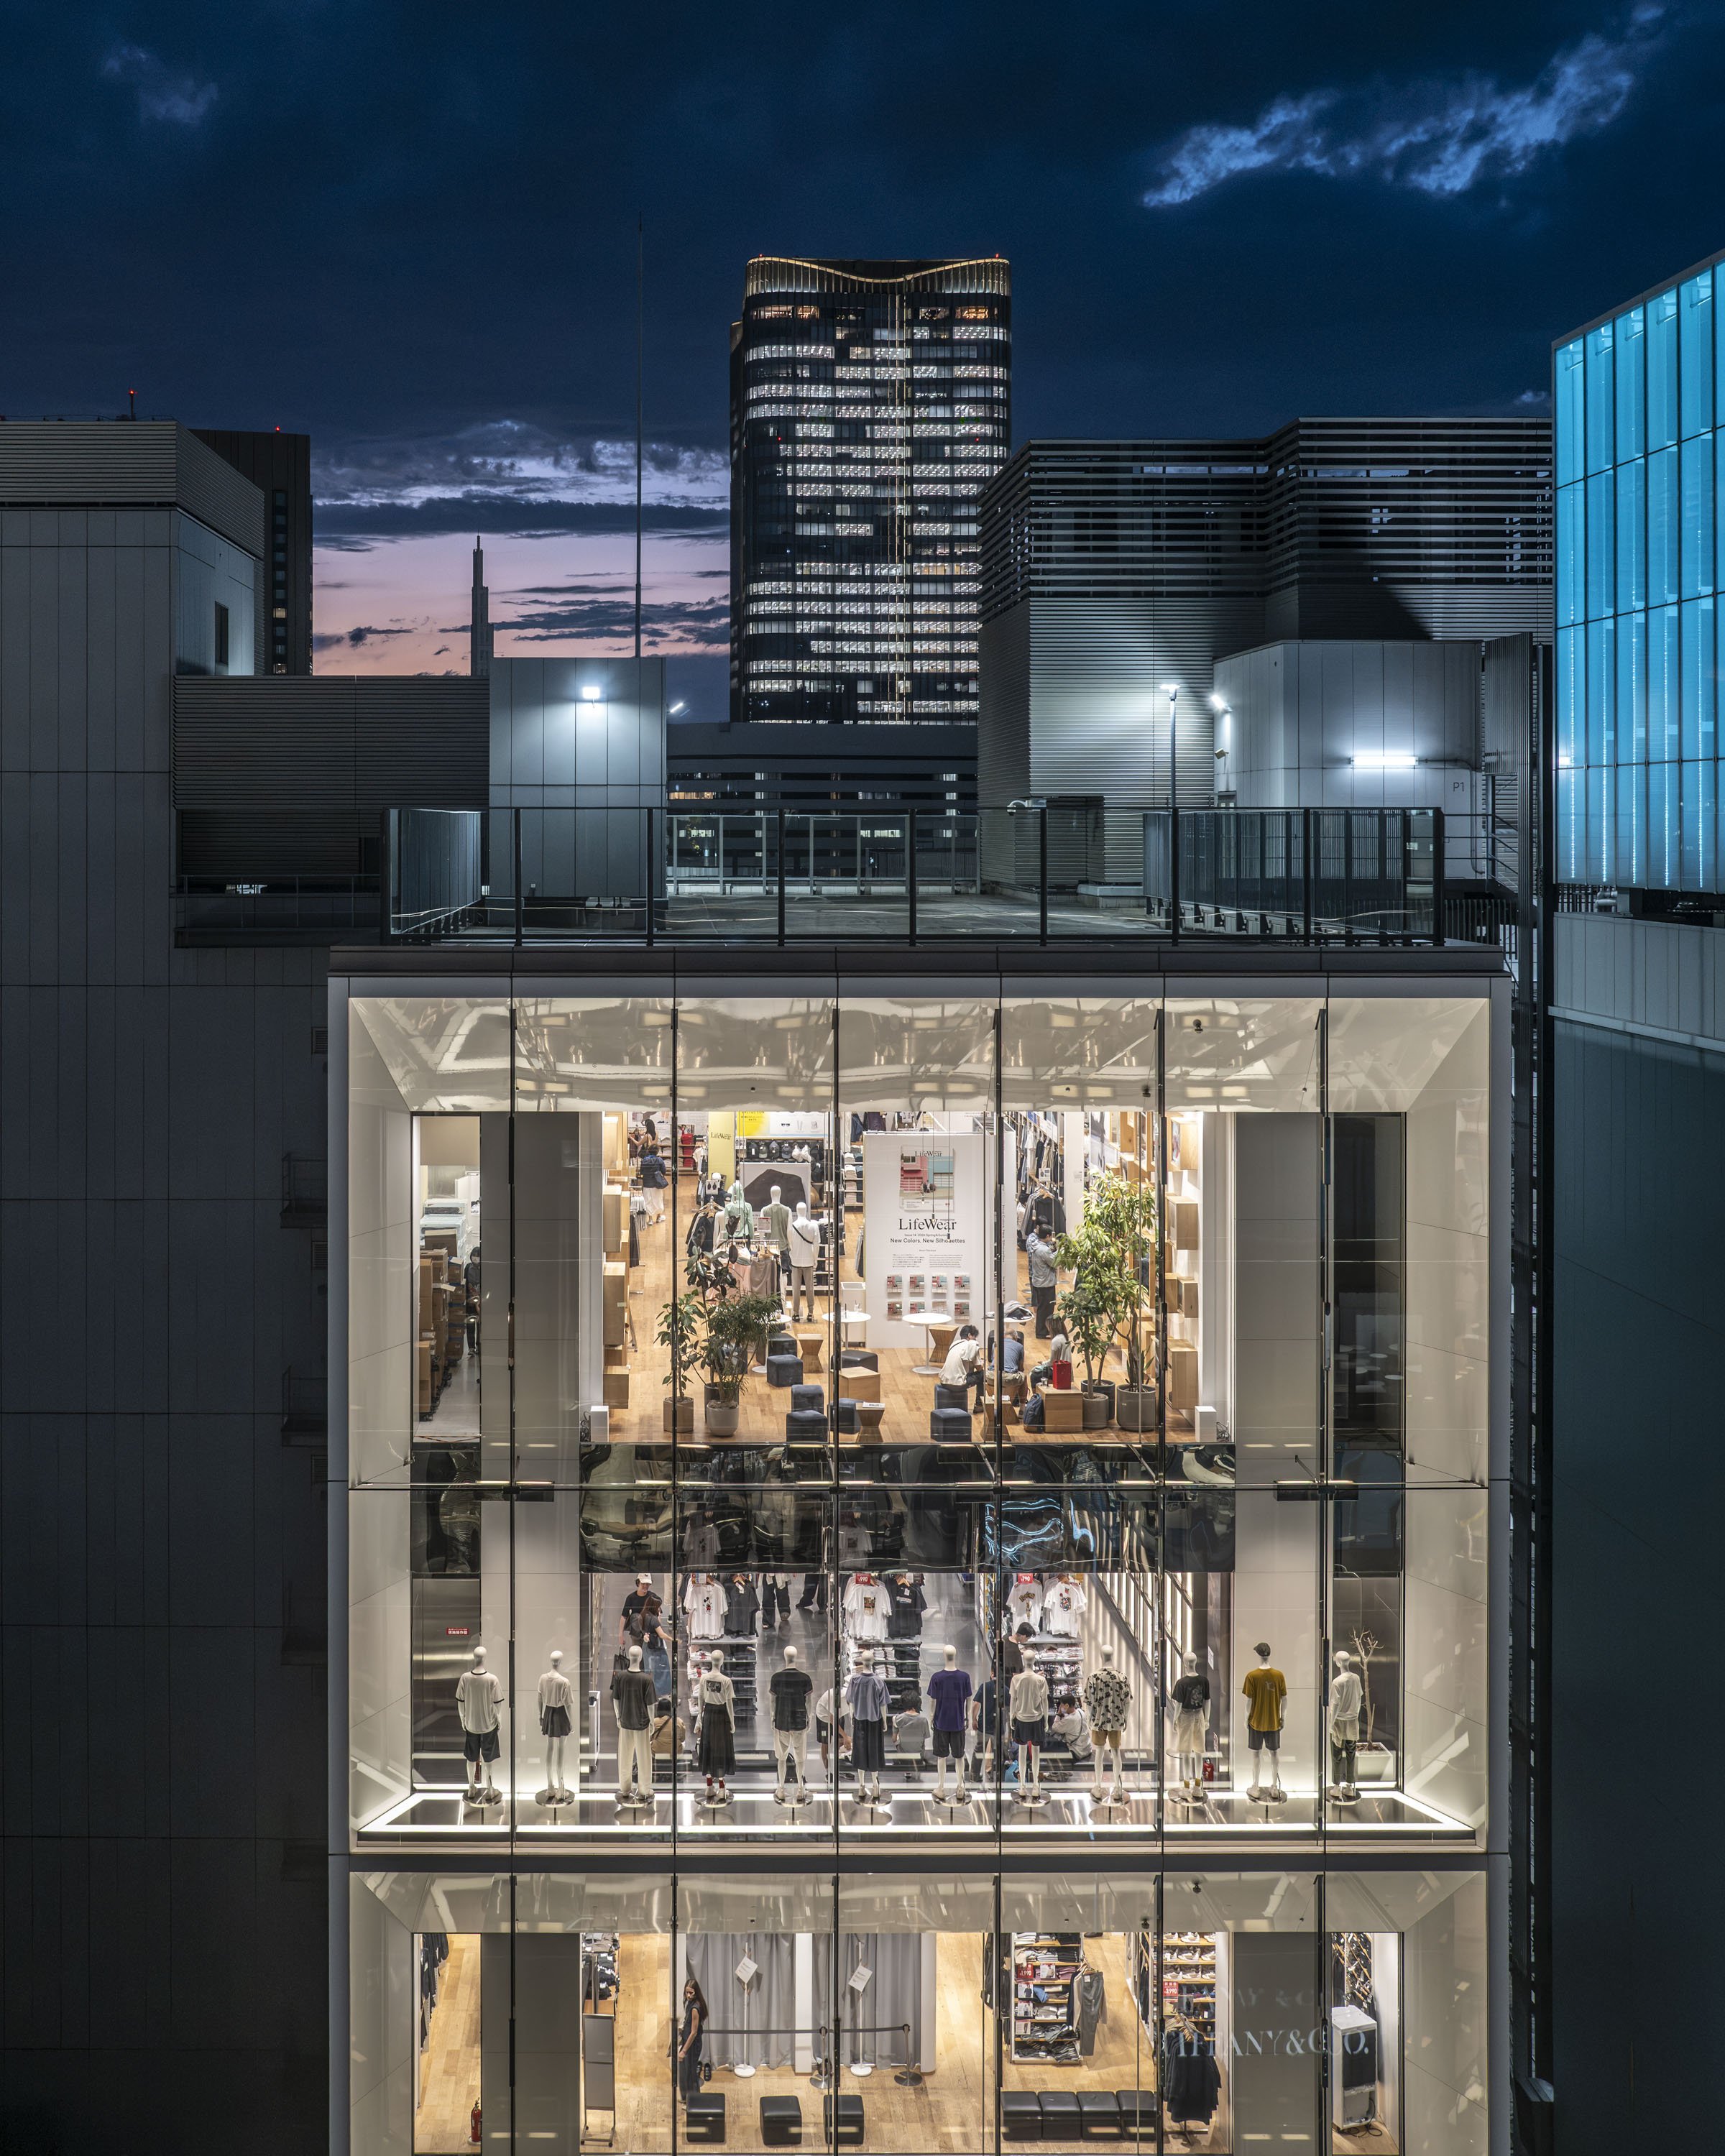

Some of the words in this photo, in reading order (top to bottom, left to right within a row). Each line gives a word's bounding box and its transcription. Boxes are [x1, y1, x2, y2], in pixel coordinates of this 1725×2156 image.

[1453, 782, 1464, 792] P1
[711, 1132, 731, 1141] LifeWear
[898, 1218, 957, 1230] LifeWear
